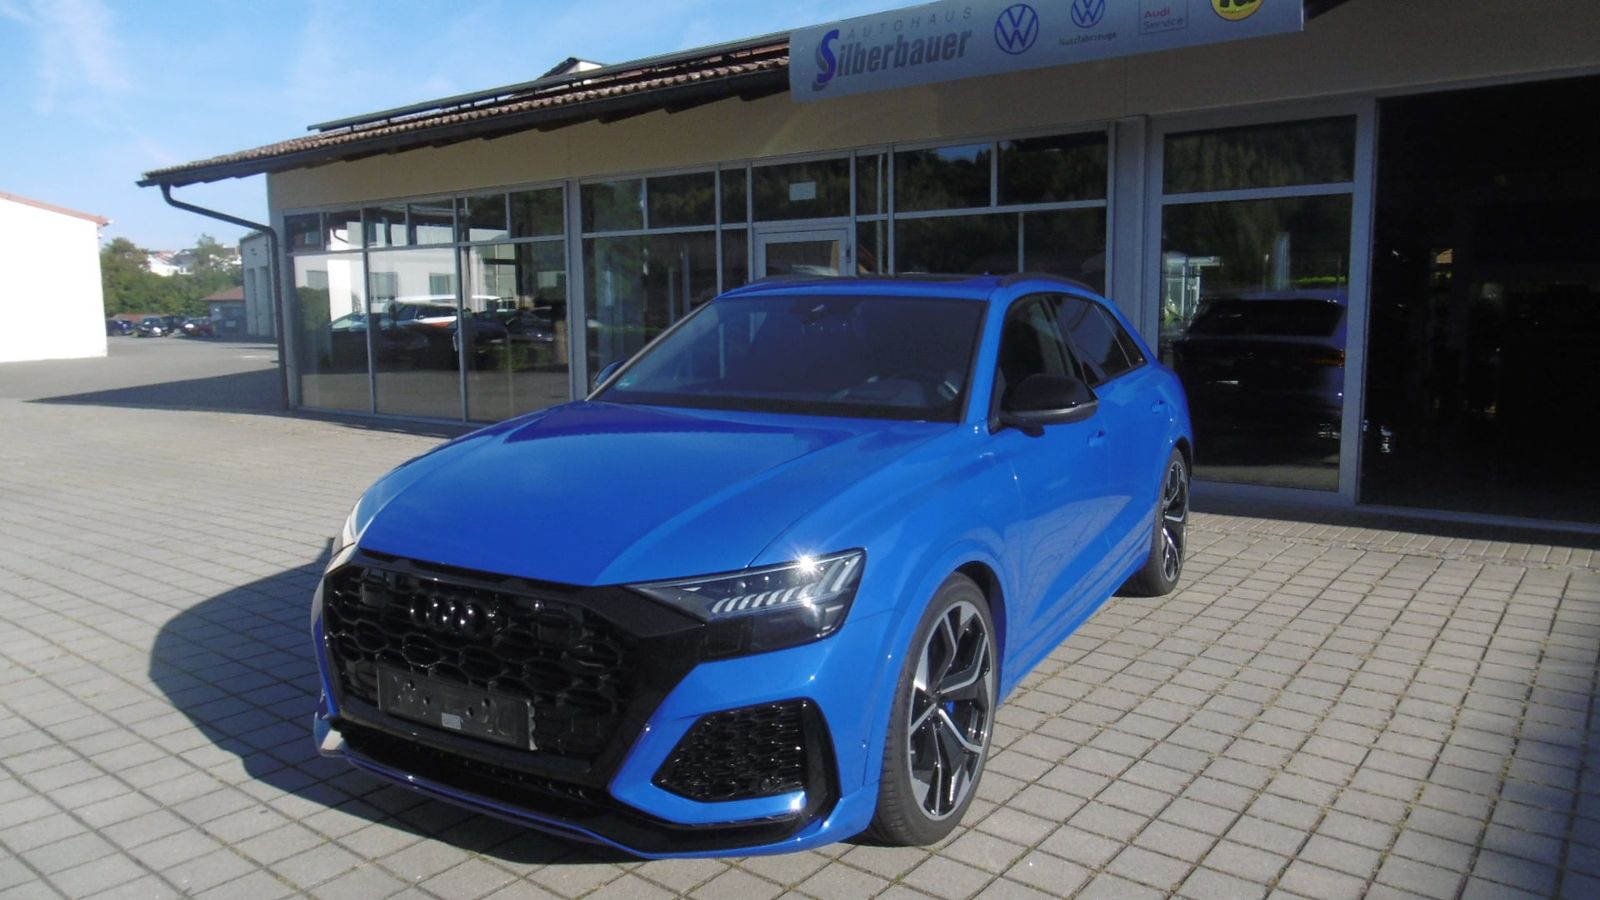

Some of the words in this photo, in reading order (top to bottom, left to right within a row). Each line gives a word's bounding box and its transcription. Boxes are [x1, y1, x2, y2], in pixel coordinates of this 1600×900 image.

[847, 6, 973, 41] AUTOHAUS
[1143, 17, 1184, 30] Service
[1144, 7, 1171, 18] Audi
[813, 29, 973, 88] Silberbauer
